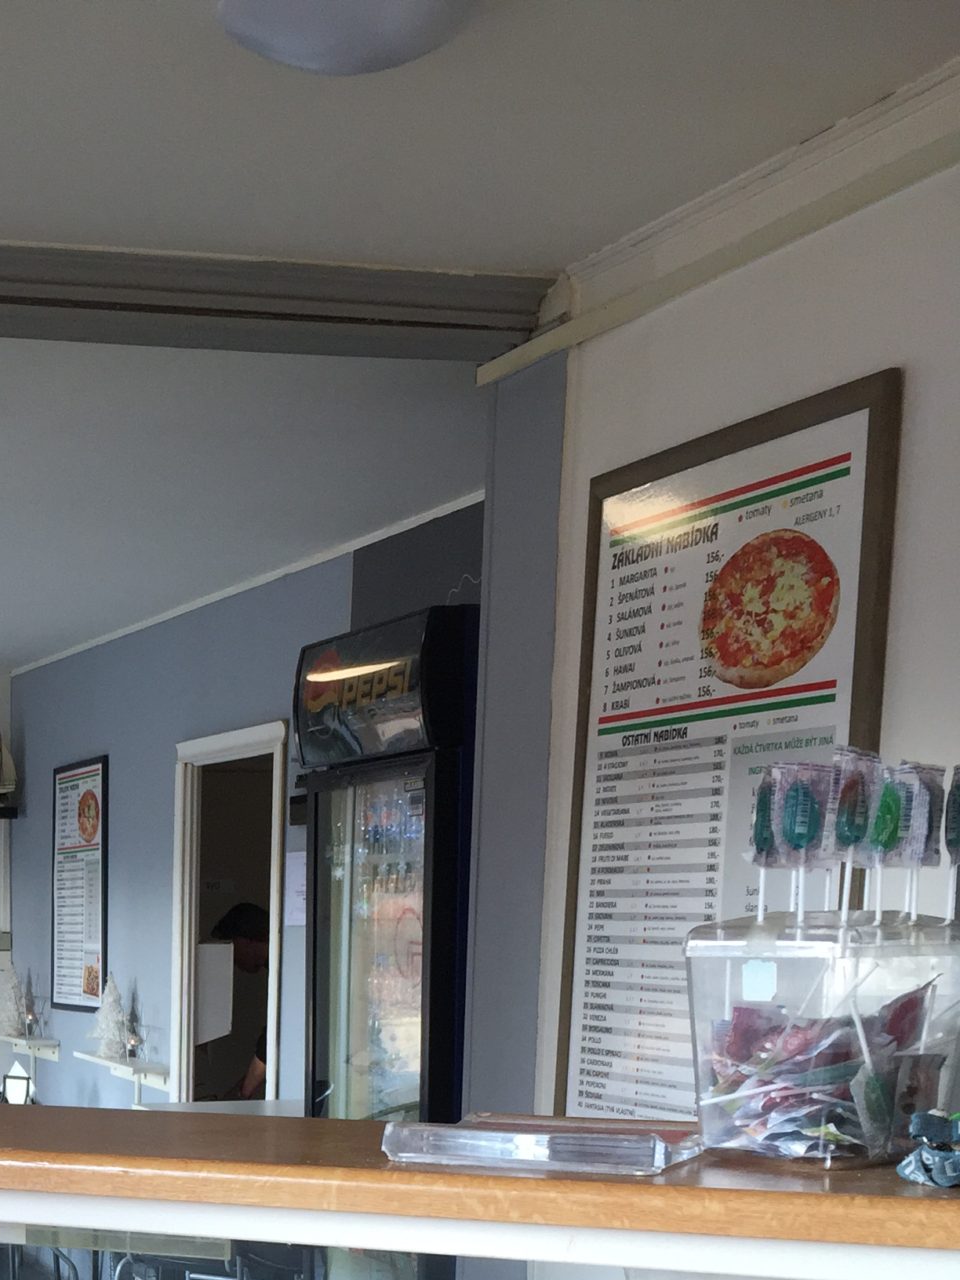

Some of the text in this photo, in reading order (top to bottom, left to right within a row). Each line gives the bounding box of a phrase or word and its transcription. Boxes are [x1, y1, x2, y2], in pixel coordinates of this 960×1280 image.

[745, 489, 823, 520] tomaty smetana
[794, 509, 827, 526] ALERGENY
[611, 522, 720, 570] ZÁKLADNÍ NABÍDKA
[619, 567, 658, 587] MARGARITA
[617, 583, 655, 605] ŠPENÁTOVÁ
[608, 615, 613, 625] 3
[616, 604, 652, 623] SALÁMOVÁ
[615, 622, 646, 640] ŠUNKOVÁ
[606, 650, 611, 660] 5
[614, 641, 642, 658] OLIVOVÁ
[341, 657, 412, 710] PEPSI
[604, 685, 609, 695] 7
[612, 674, 656, 694] ŽAMPIONOVÁ
[622, 726, 688, 747] OSTATNÍ NABÍDKA
[733, 744, 753, 755] KAŽDÁ
[755, 741, 782, 754] ČTVRTKA
[784, 738, 803, 749] MŮŽE
[805, 736, 817, 747] BÝT
